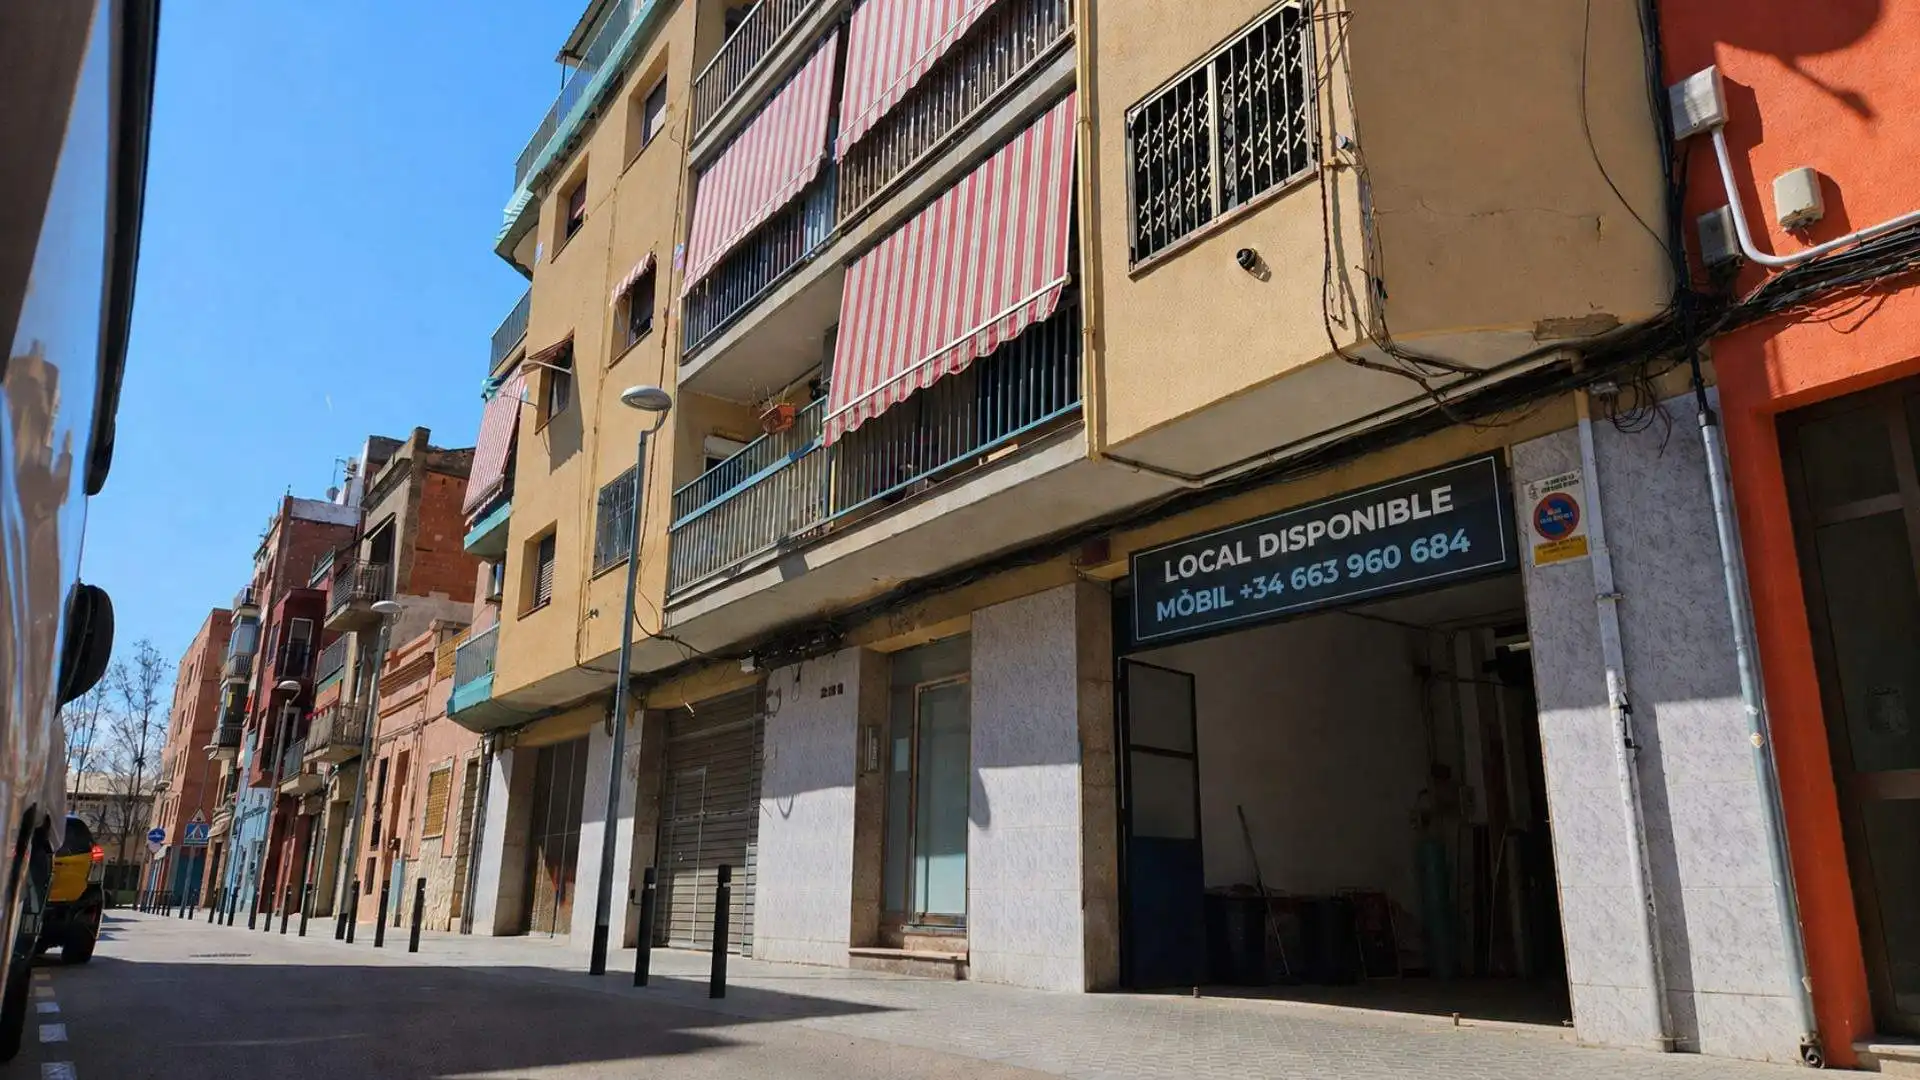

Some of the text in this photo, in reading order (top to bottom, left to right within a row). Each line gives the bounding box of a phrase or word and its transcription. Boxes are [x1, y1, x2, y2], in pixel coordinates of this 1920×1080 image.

[1164, 485, 1454, 583] LOCAL DISPONIBLE
[1240, 572, 1285, 600] +34
[1290, 559, 1340, 590] 663
[1346, 545, 1402, 579] 960
[1409, 528, 1472, 564] 684
